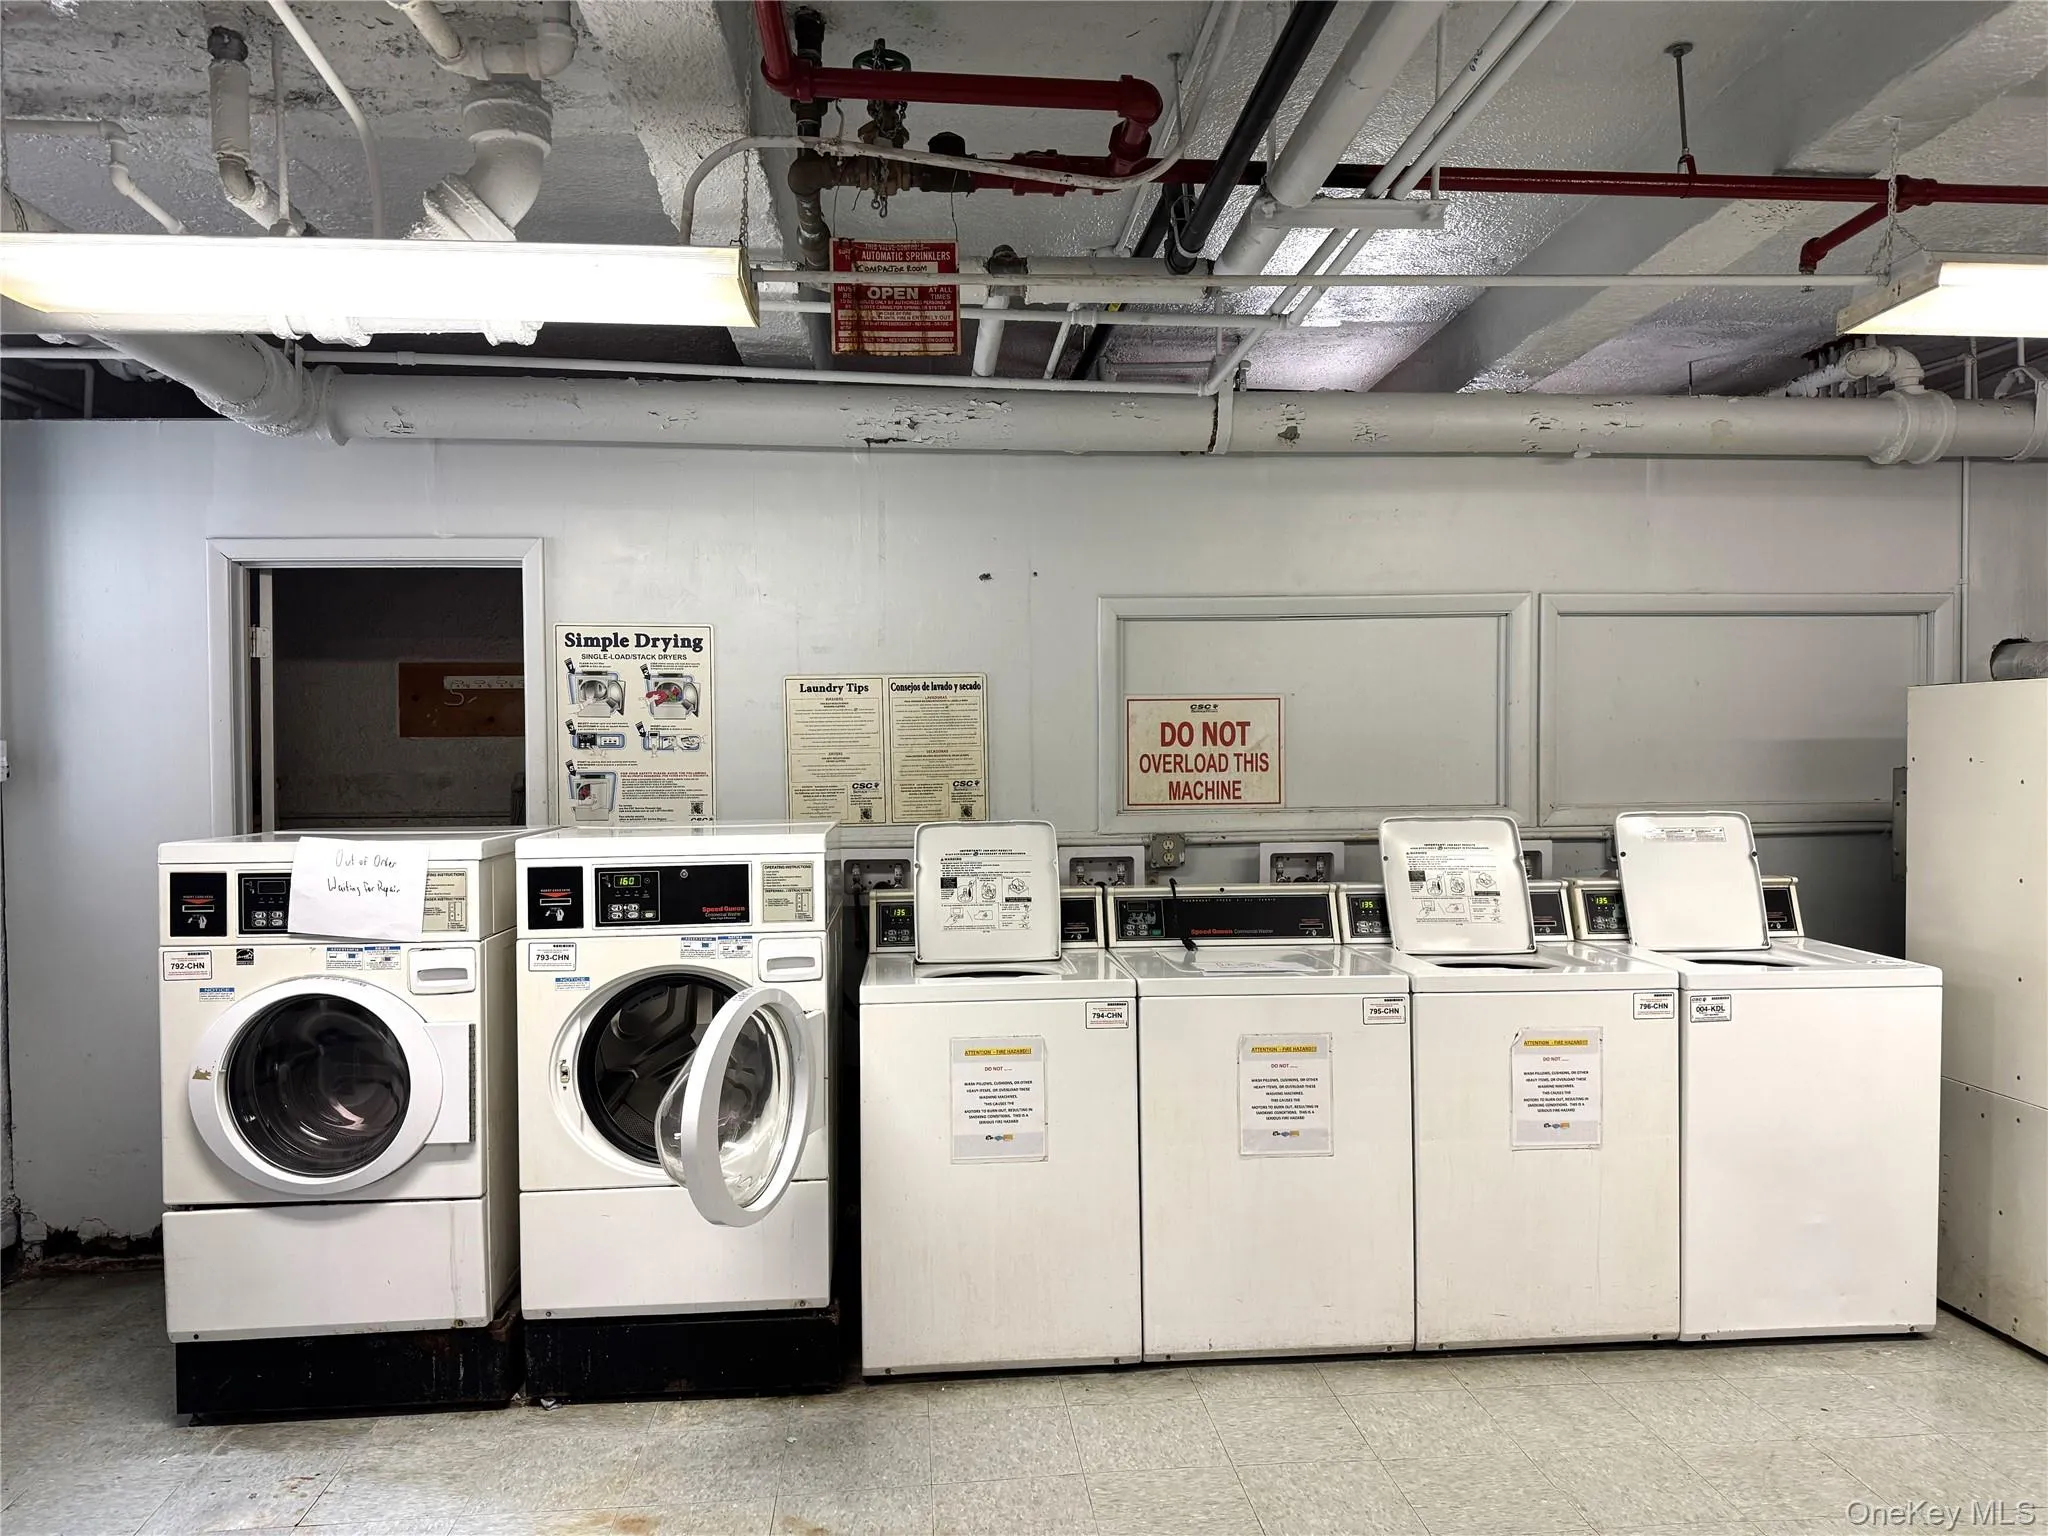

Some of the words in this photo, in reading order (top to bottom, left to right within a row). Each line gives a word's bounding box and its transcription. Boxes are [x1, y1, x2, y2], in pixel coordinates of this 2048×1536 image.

[862, 251, 903, 260] AUTOMATIC
[906, 251, 951, 260] SPRINKLERS
[867, 287, 919, 300] OPEN
[564, 632, 629, 652] Simple
[634, 632, 703, 653] Drying
[800, 683, 844, 695] Laundry
[846, 683, 869, 694] Tips
[890, 682, 920, 693] Consejos
[922, 682, 930, 691] de
[931, 681, 953, 691] lavado
[954, 684, 958, 693] y
[959, 681, 981, 690] secado
[1160, 722, 1194, 747] DO
[1202, 721, 1251, 747] NOT
[1139, 753, 1229, 773] OVERLOAD
[1233, 753, 1269, 772] THIS
[1168, 780, 1242, 800] MACHINE
[336, 848, 354, 867] Out
[359, 856, 368, 866] of
[374, 854, 397, 868] Order
[327, 876, 361, 896] Waiting
[378, 880, 400, 897] Repair
[620, 877, 634, 886] 160
